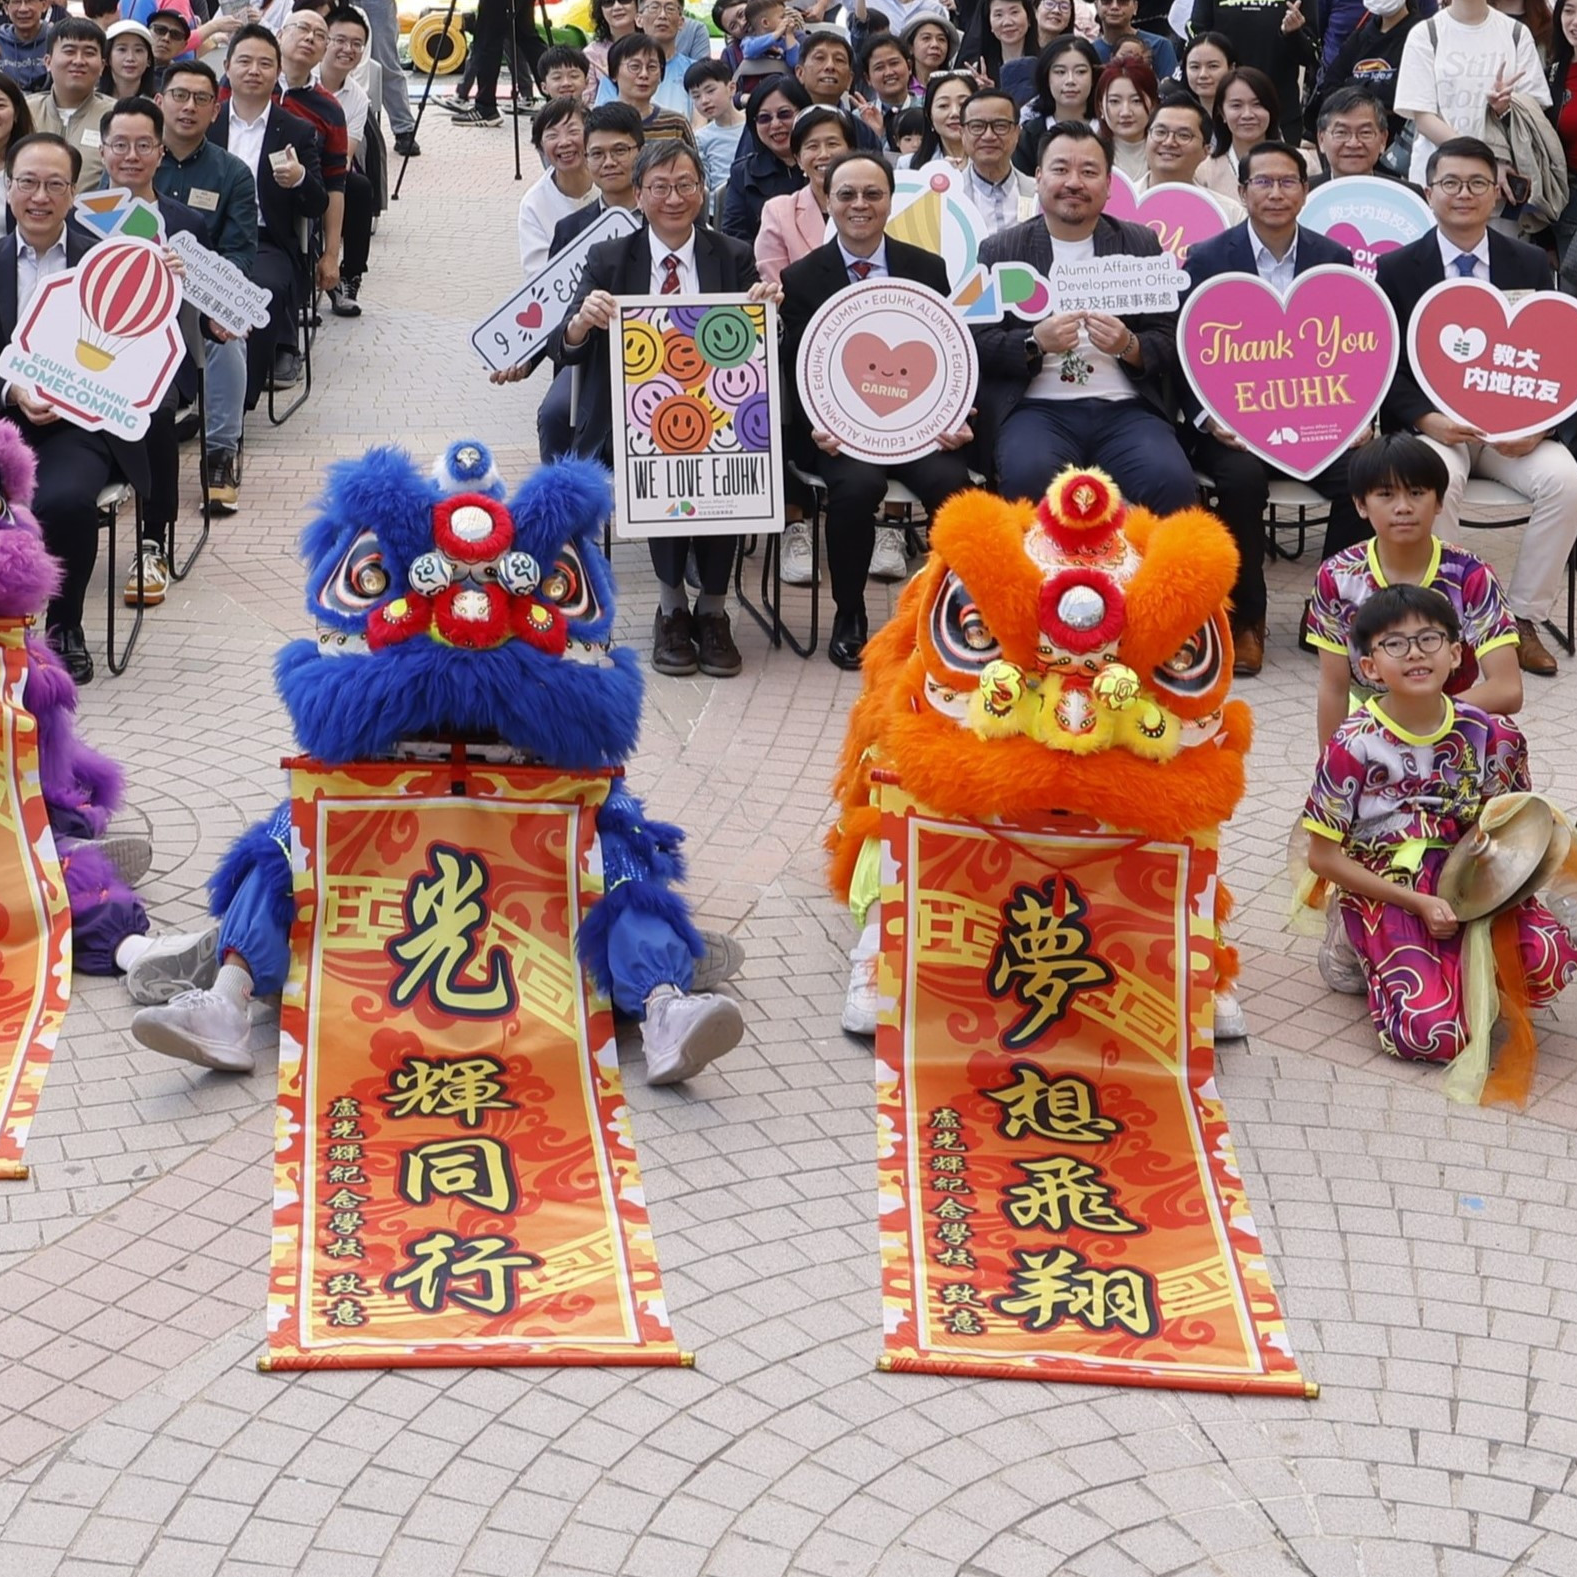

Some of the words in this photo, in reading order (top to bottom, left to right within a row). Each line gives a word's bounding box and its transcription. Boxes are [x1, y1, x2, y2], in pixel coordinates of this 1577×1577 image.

[1443, 51, 1505, 77] Still
[177, 235, 212, 267] Alumni
[211, 259, 245, 290] Affairs
[244, 283, 267, 305] and
[1055, 259, 1100, 277] Alumni
[1103, 257, 1144, 275] Affairs
[1145, 258, 1171, 271] and
[1057, 274, 1145, 293] Development
[1147, 273, 1185, 286] Office
[234, 292, 266, 323] Office
[872, 292, 916, 308] EdUHK
[917, 302, 956, 344] ALUMNI
[1059, 291, 1173, 313] 校友及拓展事務處
[813, 345, 827, 391] EdUHK
[822, 300, 864, 342] ALUMNI
[1199, 319, 1294, 368] Thank
[1298, 314, 1379, 368] You
[1492, 343, 1541, 372] 教大
[8, 354, 139, 431] HOMECOMING
[30, 352, 77, 383] EdUHK
[78, 375, 130, 408] ALUMNI
[861, 382, 910, 400] CARING
[951, 352, 964, 399] EdUHK
[1234, 374, 1356, 414] EdUHK
[820, 399, 860, 441] ALUMNI
[862, 434, 907, 449] EdUHK
[916, 400, 956, 441] ALUMNI
[633, 460, 659, 500] WE
[666, 458, 703, 498] LOVE
[713, 456, 766, 497] EdUHK!
[393, 851, 539, 1314] 光輝同行
[993, 887, 1152, 1334] 夢想飛翔
[326, 1097, 367, 1259] 盧光輝紀念學校
[929, 1108, 977, 1268] 盧光輝紀念學校
[326, 1273, 369, 1325] 致意
[943, 1285, 983, 1335] 致意
